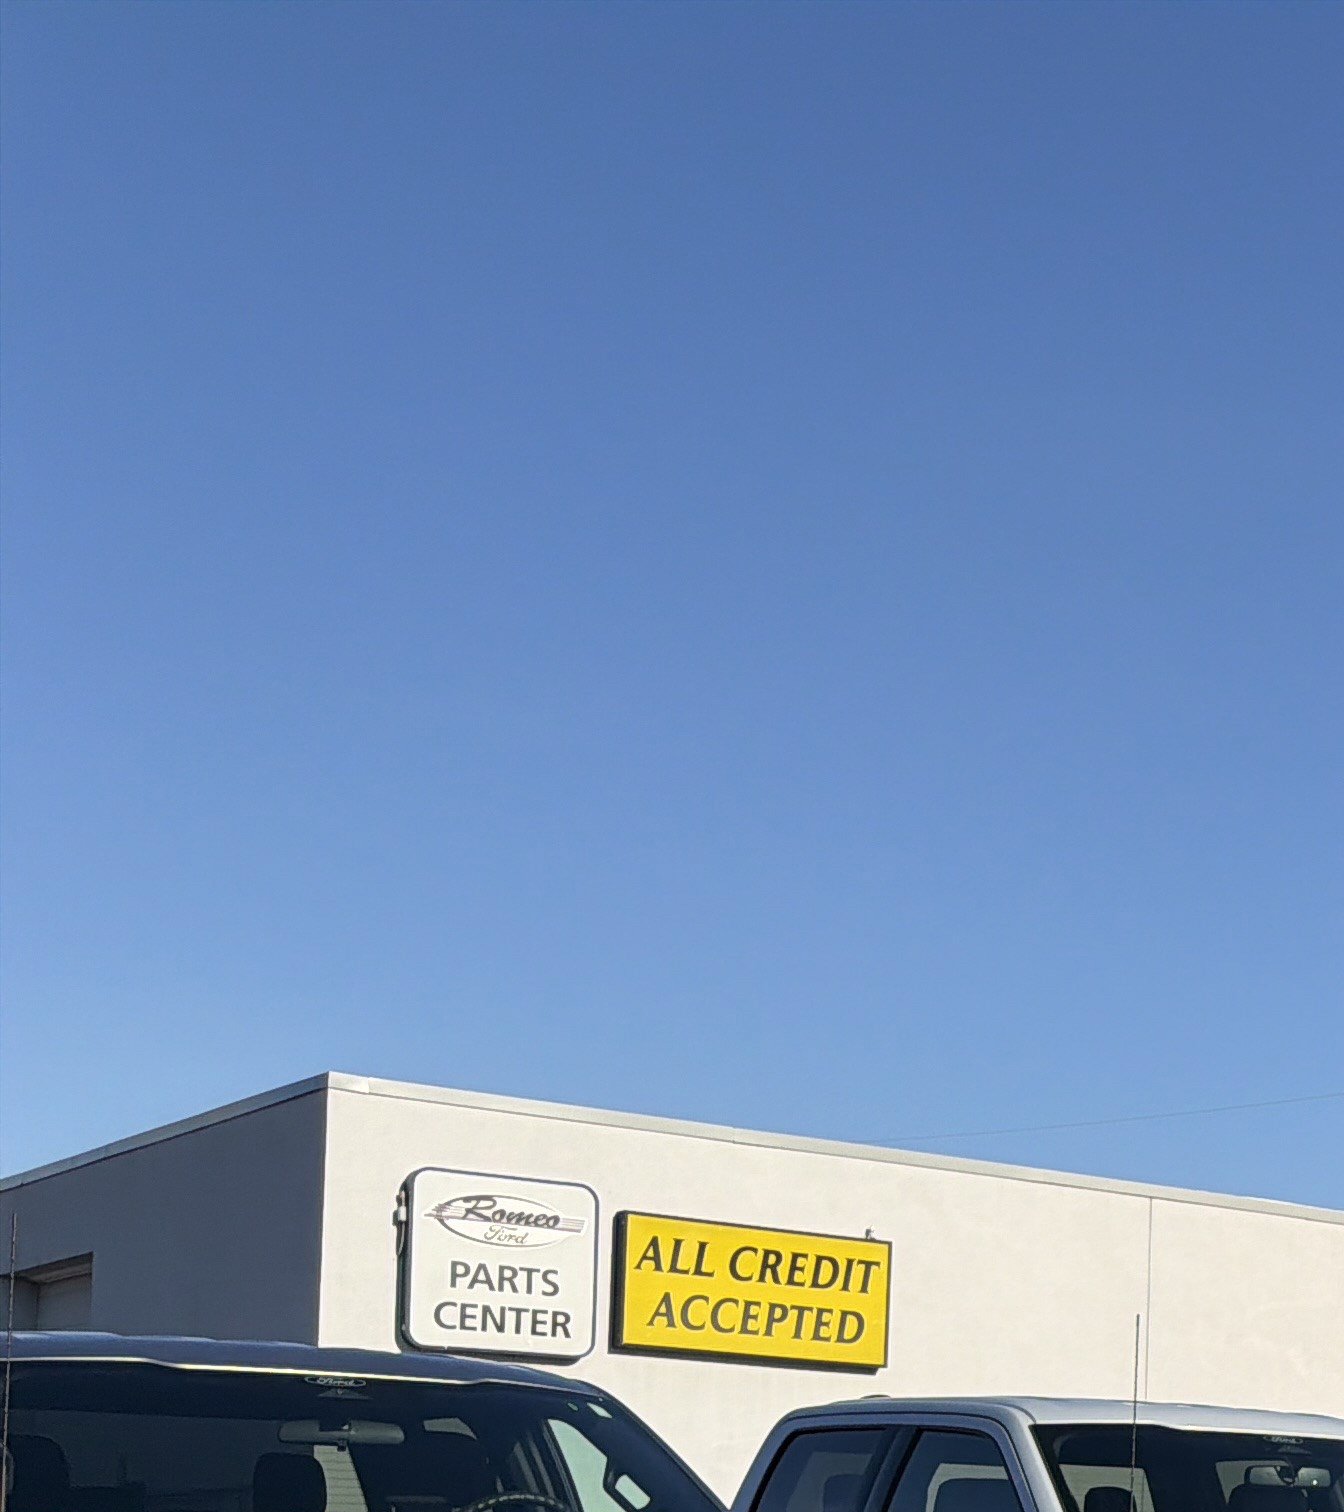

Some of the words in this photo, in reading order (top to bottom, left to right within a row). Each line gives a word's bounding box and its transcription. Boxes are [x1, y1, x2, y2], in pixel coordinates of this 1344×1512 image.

[462, 1195, 561, 1229] Romeo
[484, 1223, 529, 1247] Ford
[449, 1260, 560, 1297] PARTS
[634, 1235, 716, 1278] ALL
[728, 1245, 882, 1294] CREDIT
[433, 1301, 572, 1339] CENTER
[646, 1291, 866, 1345] ACCEPTED
